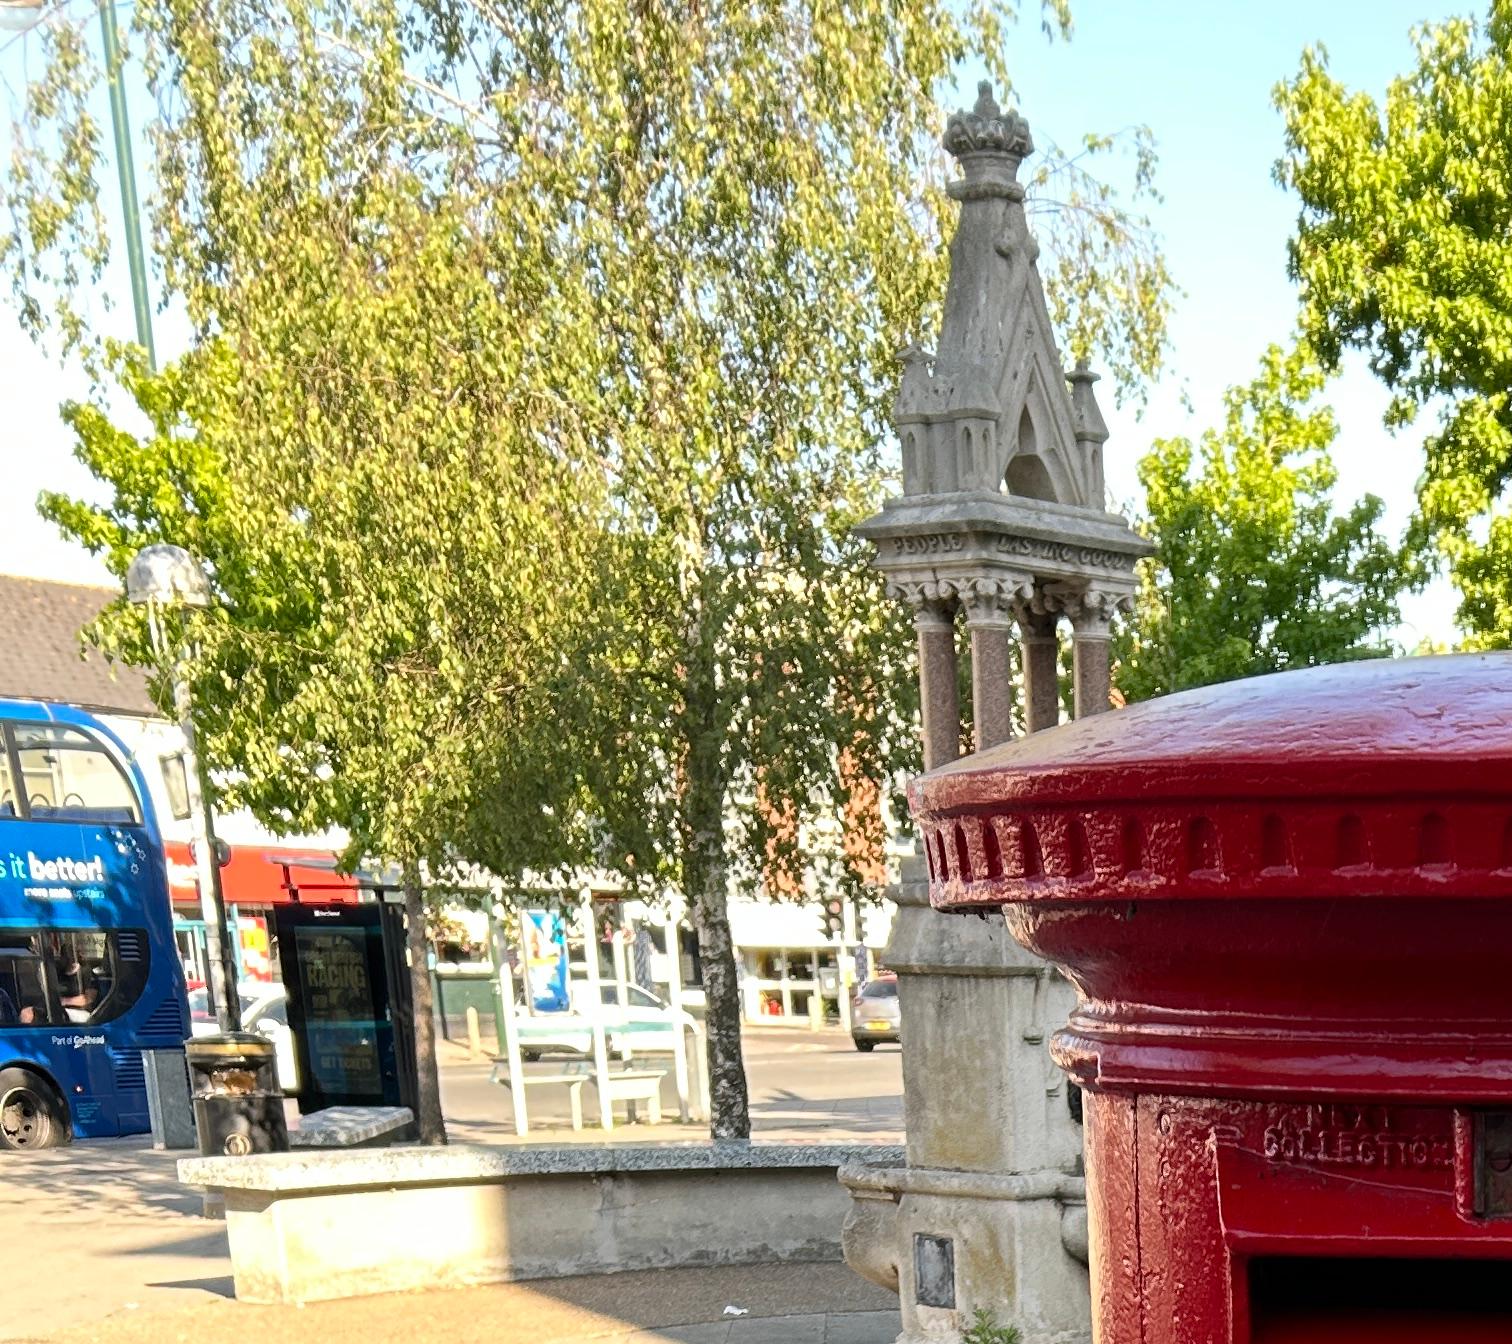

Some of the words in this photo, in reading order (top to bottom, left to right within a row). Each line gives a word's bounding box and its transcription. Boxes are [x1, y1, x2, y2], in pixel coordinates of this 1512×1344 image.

[9, 852, 27, 879] it
[28, 851, 103, 881] better!
[307, 965, 366, 988] RACING
